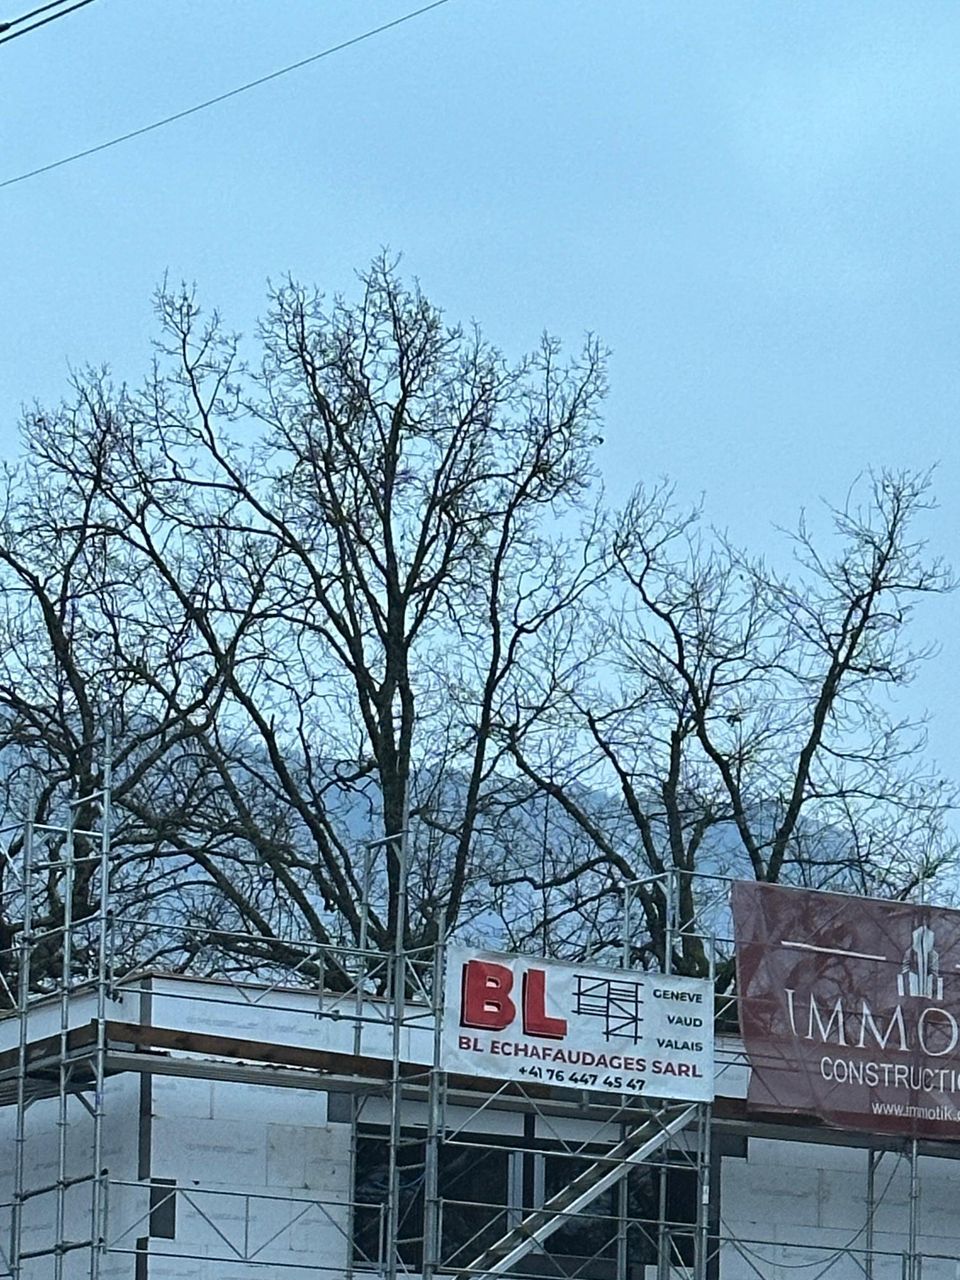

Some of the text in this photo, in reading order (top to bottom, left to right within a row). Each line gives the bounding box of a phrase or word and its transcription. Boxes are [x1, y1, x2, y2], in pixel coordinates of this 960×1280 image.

[460, 960, 567, 1040] BL
[653, 988, 703, 1004] GENEVE
[667, 1015, 703, 1028] VAUD
[657, 1038, 703, 1051] VALAIS
[458, 1036, 703, 1078] BL ECHAFAUDAGES SARL
[519, 1065, 646, 1091] +41 76 447 45 47
